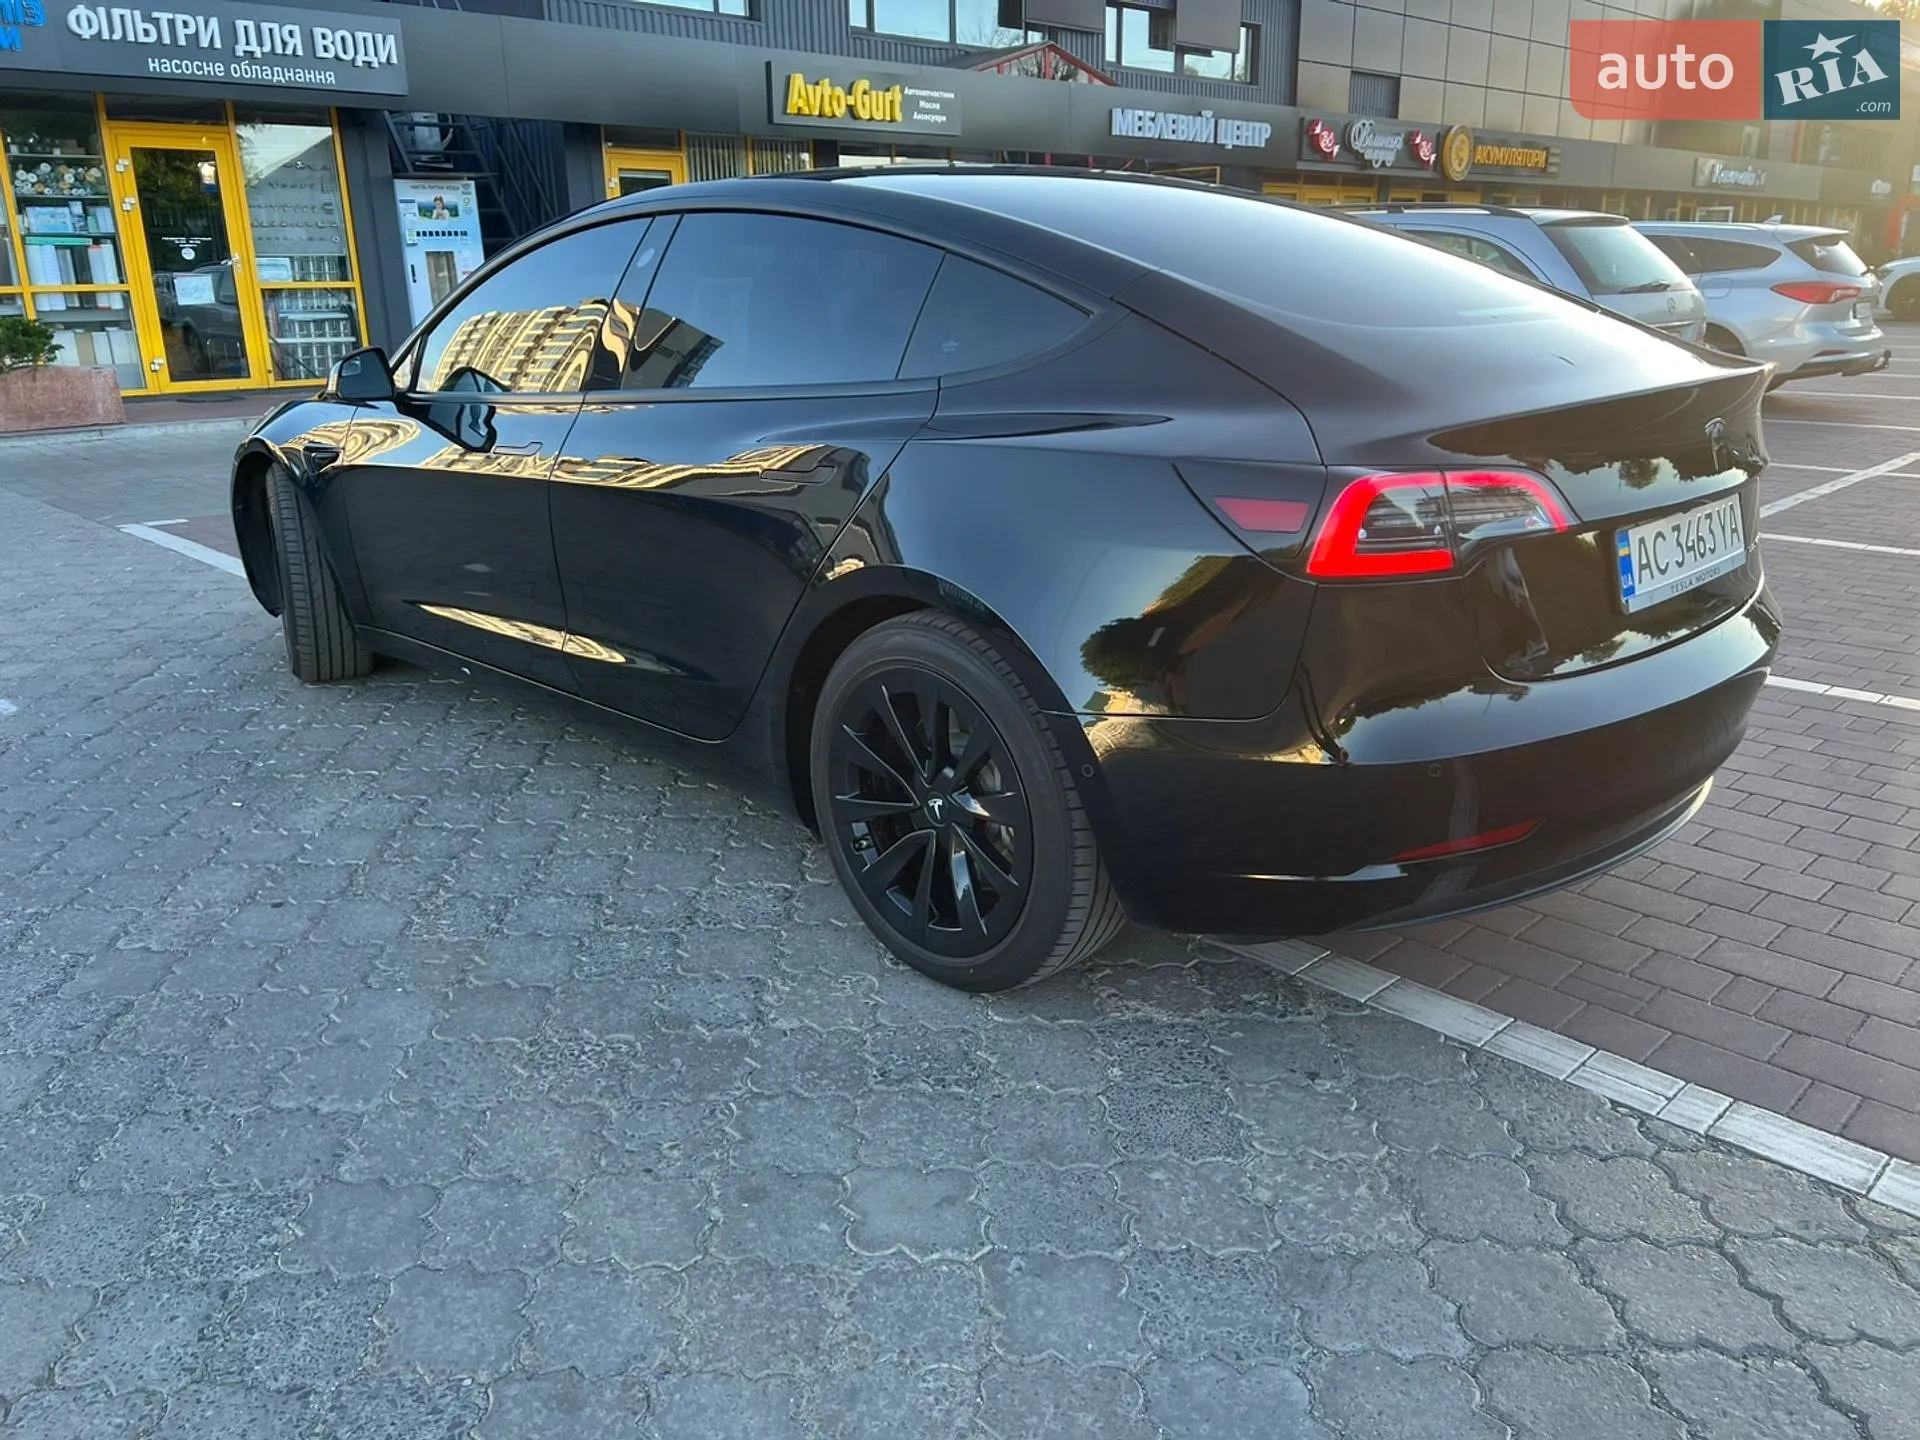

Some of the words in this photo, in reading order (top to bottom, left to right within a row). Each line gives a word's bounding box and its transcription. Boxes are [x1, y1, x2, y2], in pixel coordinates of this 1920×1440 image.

[67, 5, 222, 50] ФІЛЬТРИ
[234, 19, 304, 59] ДЛЯ
[313, 27, 398, 69] ВОДИ
[148, 55, 225, 78] насосне
[230, 62, 336, 85] обладнання
[786, 72, 903, 123] Avto-Gurt
[1110, 107, 1214, 144] МЕБЛЕВИЙ
[1216, 117, 1272, 149] ЦЕНТР
[1474, 144, 1548, 169] АКУМУЛЯТОРИ
[1669, 581, 1694, 595] TESLA
[1694, 567, 1721, 586] MOTORS
